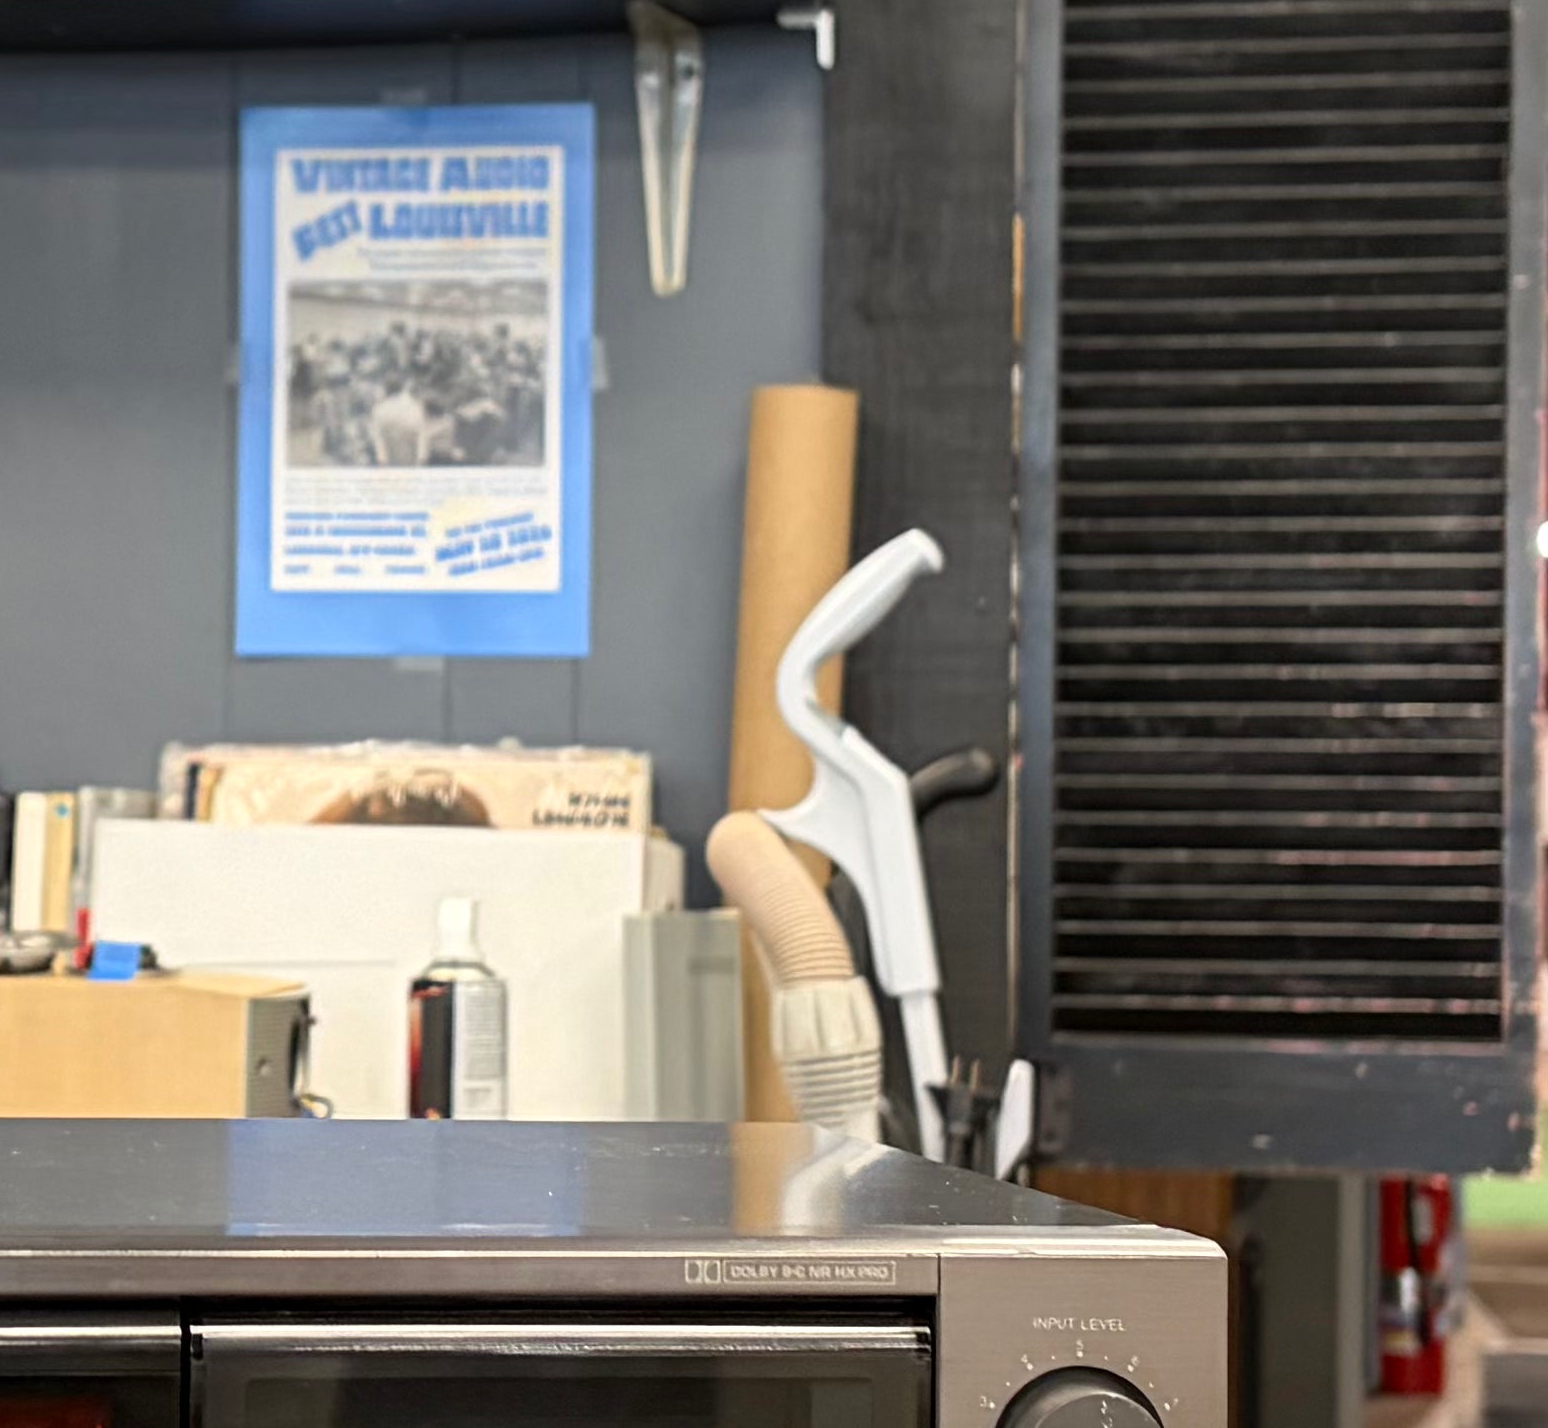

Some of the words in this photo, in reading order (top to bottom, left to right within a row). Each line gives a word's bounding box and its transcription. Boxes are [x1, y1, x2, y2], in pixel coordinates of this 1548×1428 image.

[729, 1264, 779, 1279] DOLBY
[809, 1264, 831, 1279] NR
[834, 1264, 856, 1279] HX
[859, 1264, 889, 1280] PRO
[1032, 1317, 1075, 1330] INPUT
[1080, 1318, 1127, 1331] LEVEL
[1075, 1339, 1084, 1351] 5
[979, 1396, 988, 1408] 3
